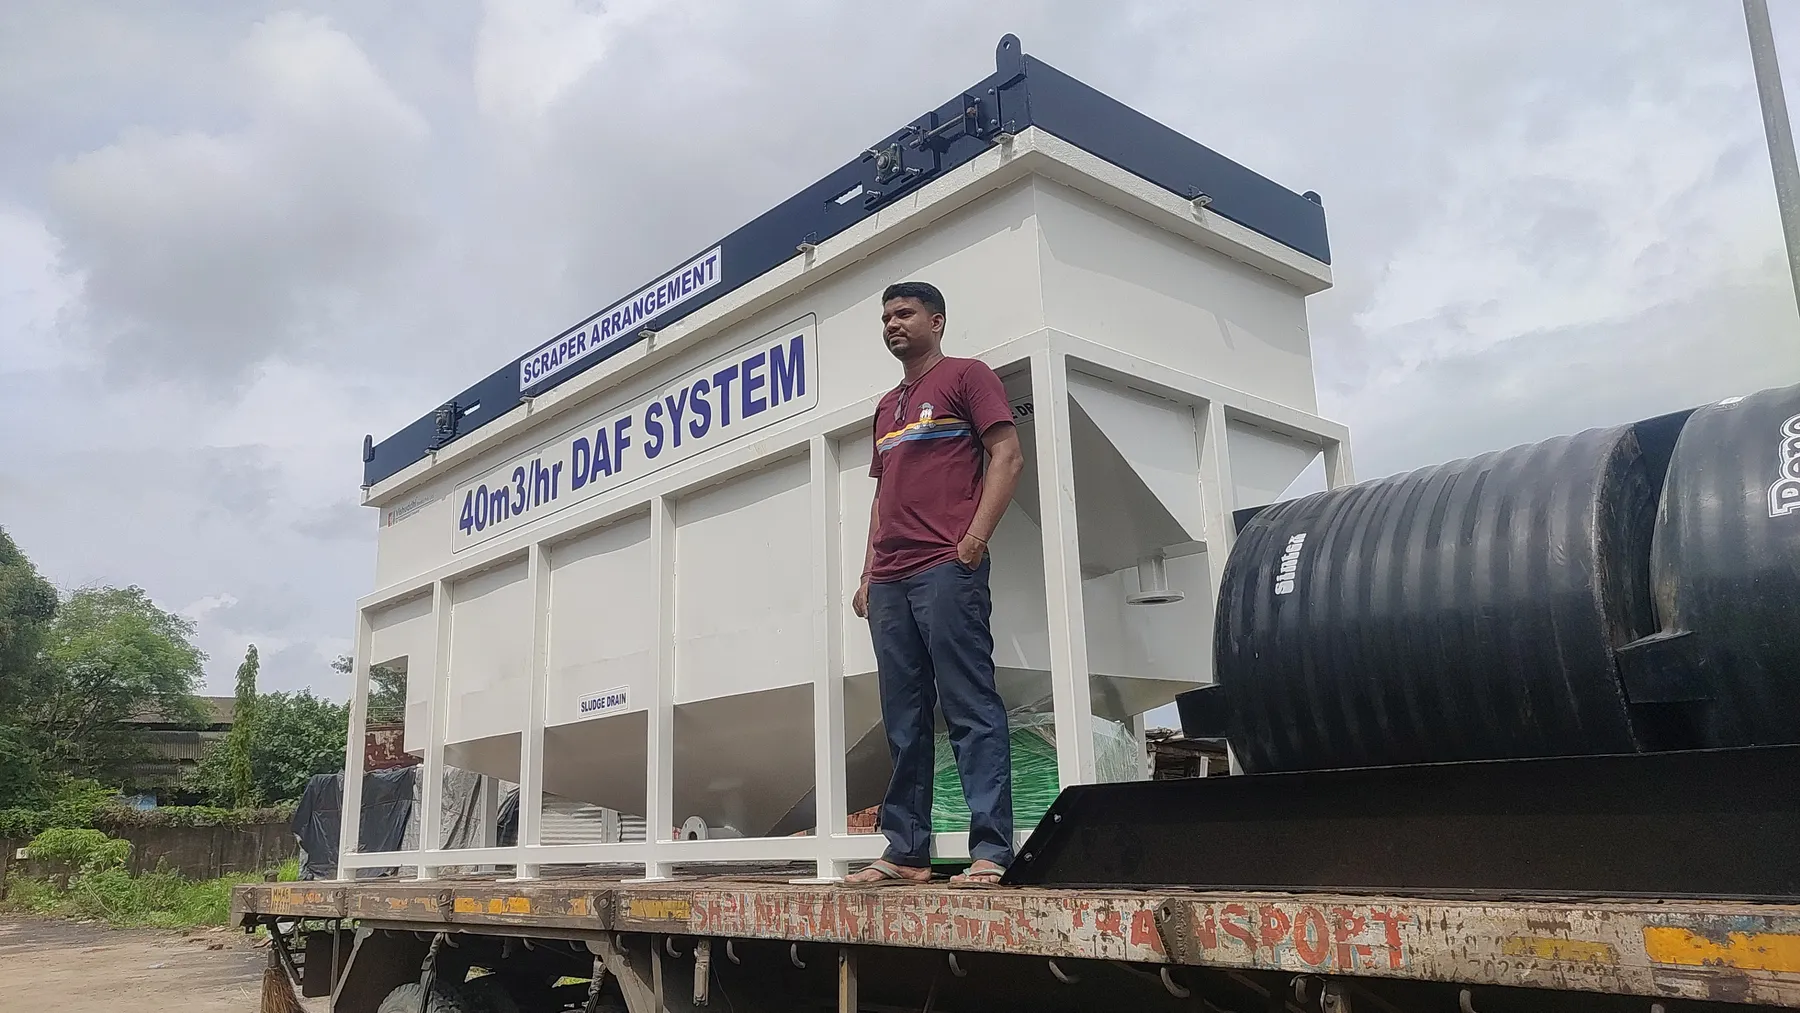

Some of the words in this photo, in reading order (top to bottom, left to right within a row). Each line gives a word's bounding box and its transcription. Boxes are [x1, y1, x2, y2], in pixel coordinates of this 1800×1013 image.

[524, 331, 586, 383] SCRAPER
[590, 255, 717, 347] ARRANGEMENT
[459, 457, 563, 536] 40m3/hr
[571, 415, 633, 491] DAF
[644, 334, 806, 460] SYSTEM
[1275, 533, 1307, 595] Sintex
[581, 697, 605, 712] SLUDGE
[607, 692, 627, 707] DRAIN
